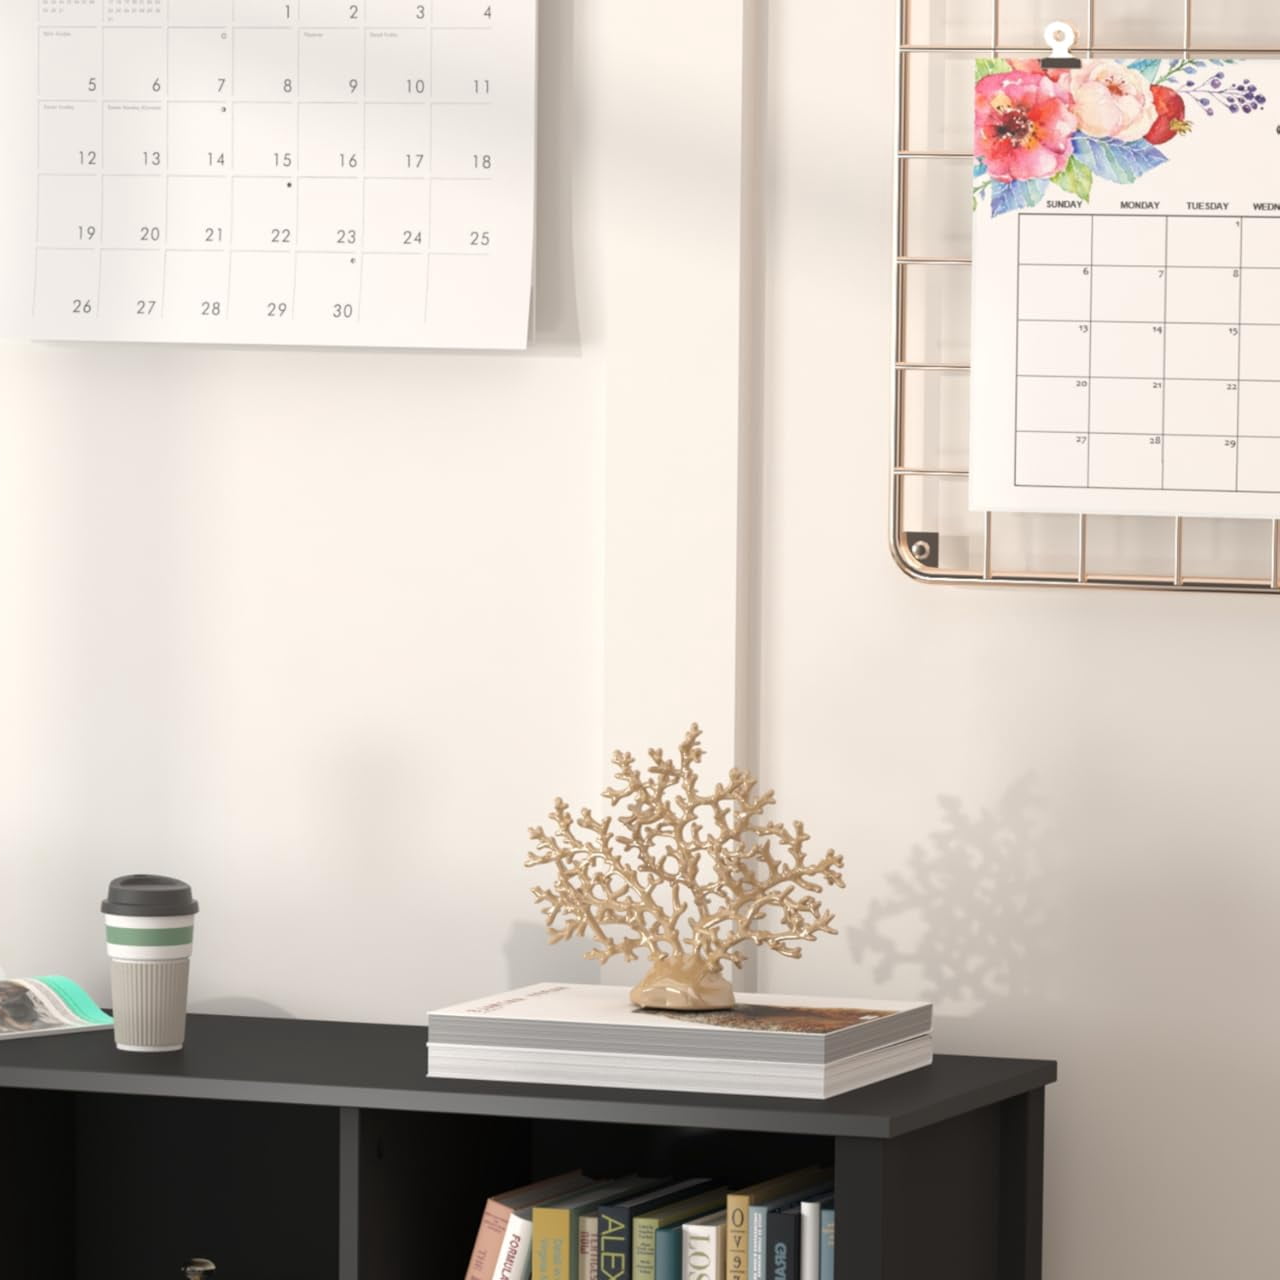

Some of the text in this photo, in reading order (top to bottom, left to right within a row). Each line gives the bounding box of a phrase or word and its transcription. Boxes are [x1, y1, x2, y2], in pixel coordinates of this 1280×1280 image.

[285, 4, 492, 20] 1 2 3 4
[87, 77, 490, 95] 5 6 7 8 9 10 11
[79, 150, 492, 170] 12 13 14 15 16 17 18
[1046, 200, 1083, 209] SUNDAY
[1120, 201, 1160, 210] MONDAY
[1187, 202, 1229, 210] TUESDAY
[78, 225, 490, 246] 19 20 21 22 23 24 25
[1082, 267, 1089, 275] 6
[1158, 269, 1164, 278] 7
[72, 298, 353, 319] 26 27 28 29 30
[1078, 324, 1238, 336] 13 14 15
[1075, 436, 1087, 444] 27
[1224, 439, 1236, 448] 29
[500, 1233, 521, 1280] FORMULA
